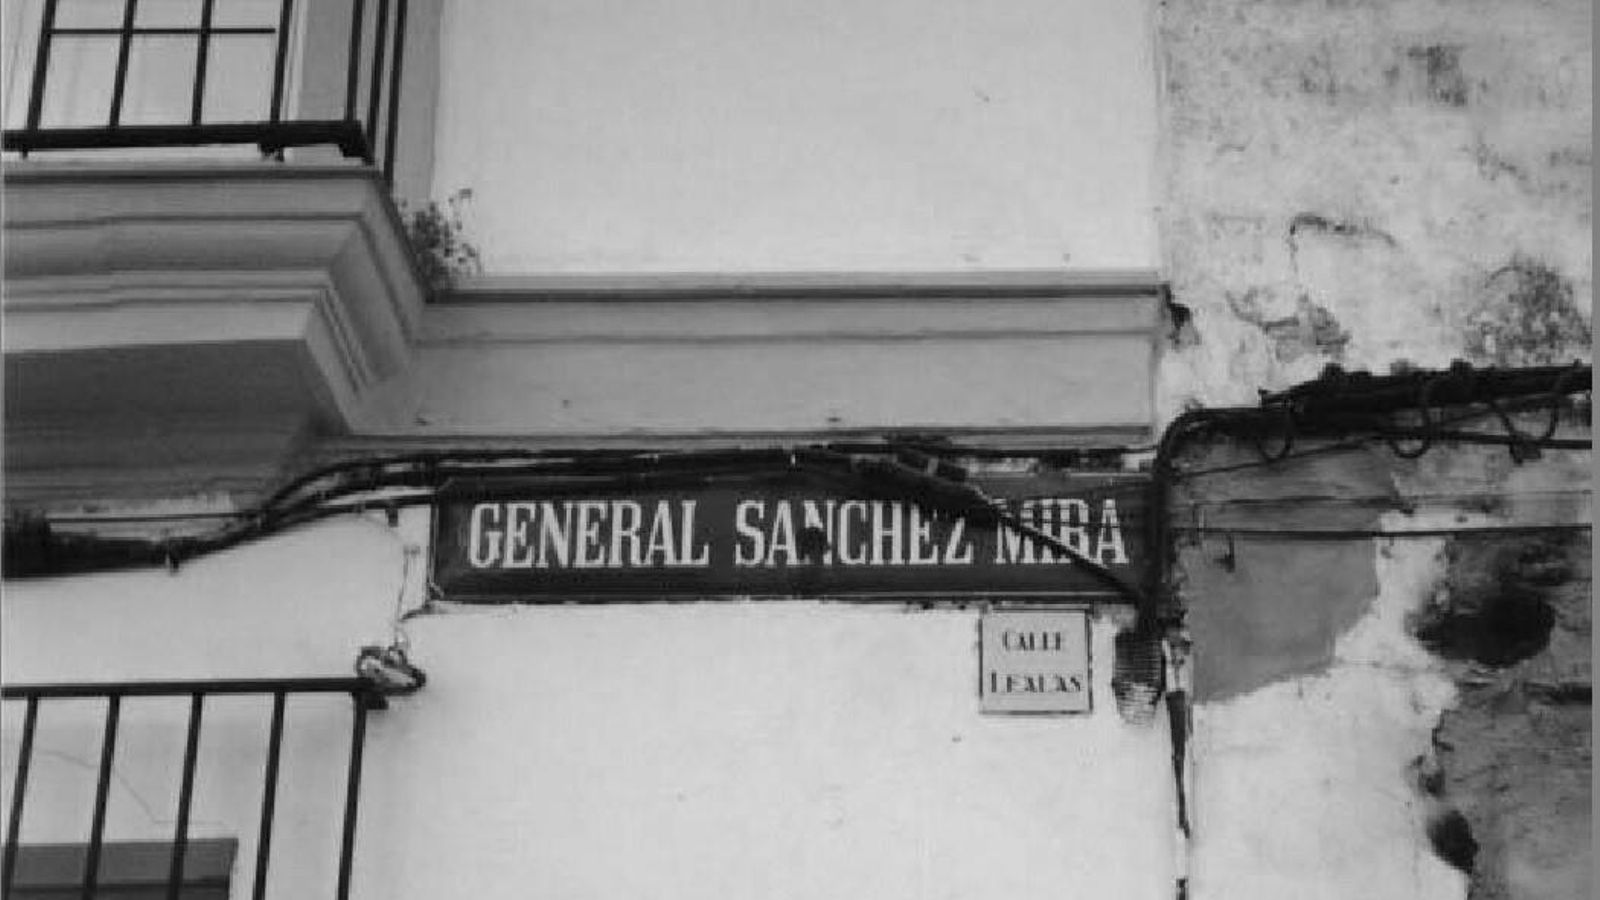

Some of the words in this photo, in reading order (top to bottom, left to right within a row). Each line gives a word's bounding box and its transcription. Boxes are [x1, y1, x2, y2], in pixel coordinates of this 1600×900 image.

[470, 499, 709, 568] GENERAL
[996, 498, 1129, 565] MIRA
[1002, 630, 1063, 651] CALLE
